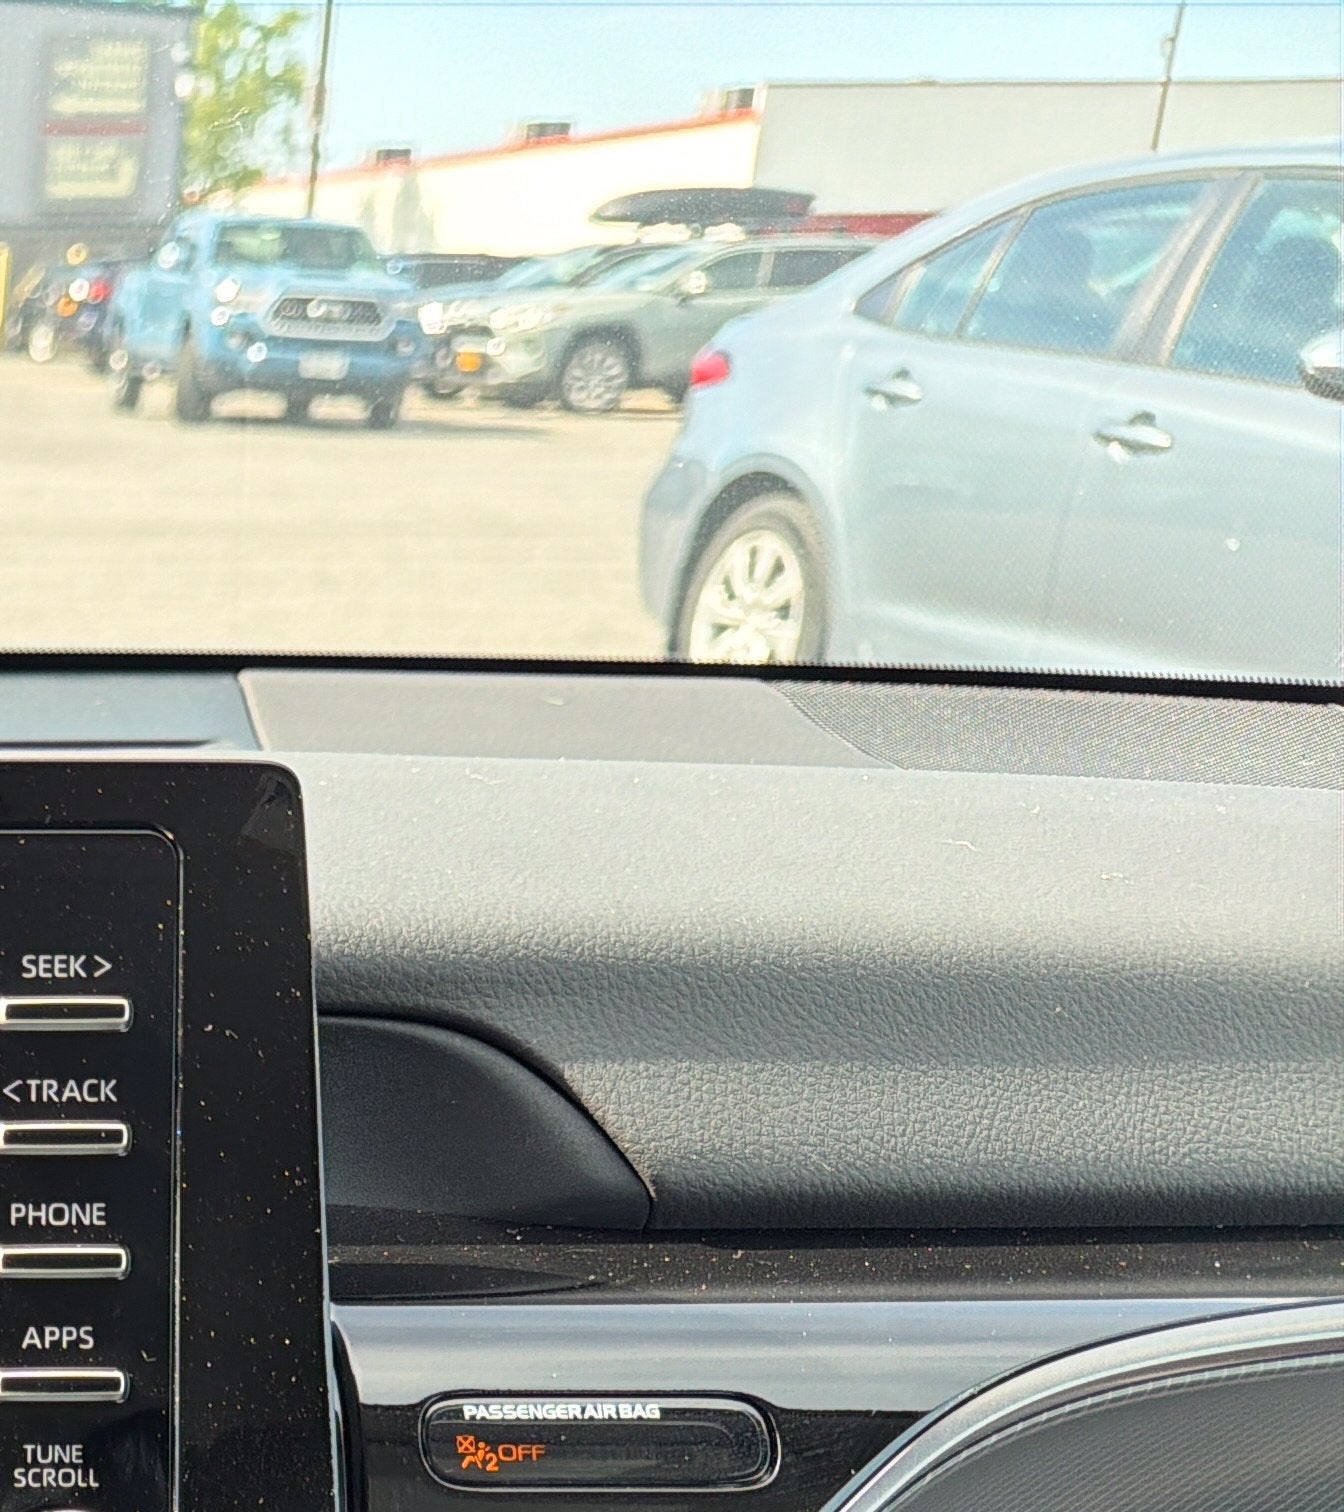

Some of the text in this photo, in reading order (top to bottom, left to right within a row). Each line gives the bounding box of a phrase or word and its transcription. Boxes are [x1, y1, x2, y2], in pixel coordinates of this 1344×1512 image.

[21, 954, 88, 979] SEEK
[10, 1202, 107, 1228] PHONE
[21, 1326, 95, 1351] APPS
[463, 1404, 584, 1421] PASSENGER
[619, 1403, 661, 1420] BAG
[23, 1444, 84, 1464] TUNE
[498, 1443, 546, 1463] OFF
[13, 1468, 100, 1488] SCROLL
